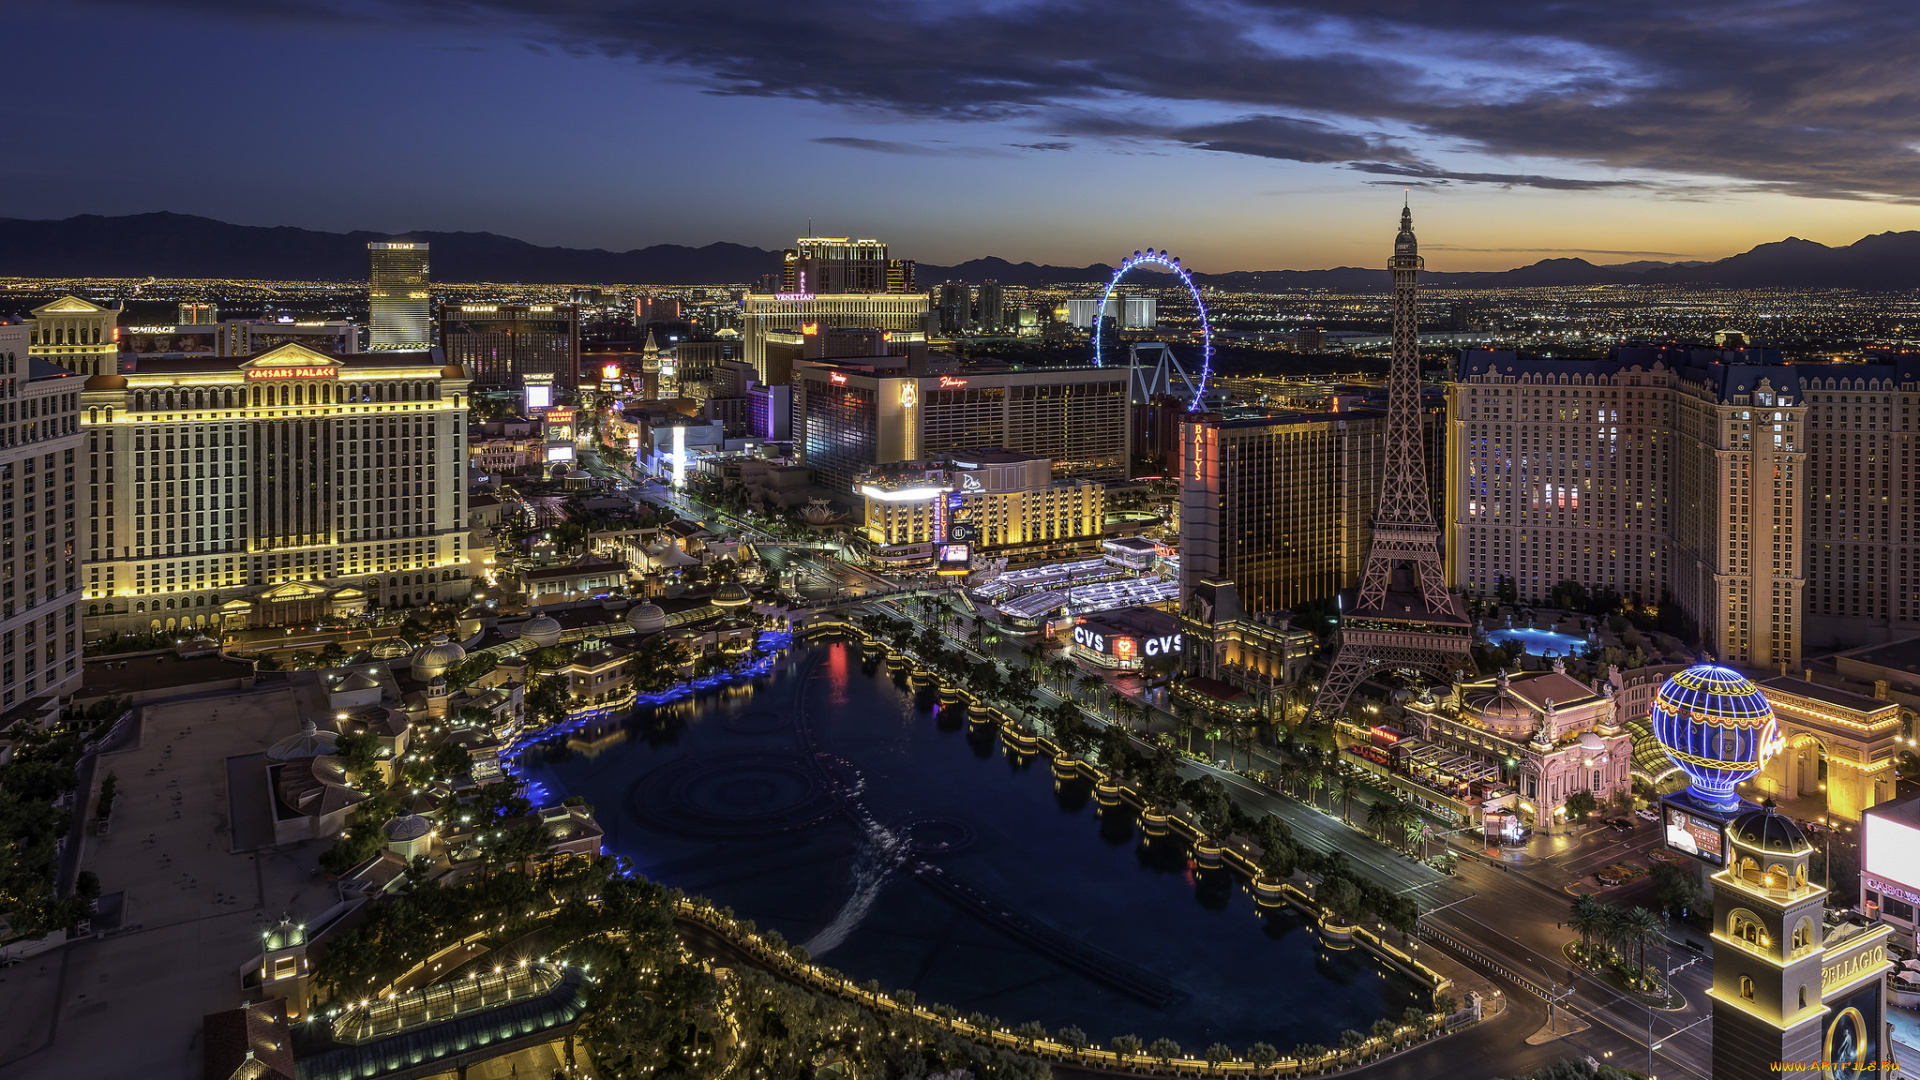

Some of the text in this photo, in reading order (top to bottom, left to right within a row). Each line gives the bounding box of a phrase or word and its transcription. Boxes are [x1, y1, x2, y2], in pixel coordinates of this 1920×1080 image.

[775, 293, 814, 301] VENETIAN
[139, 326, 176, 335] MIRAGE
[248, 368, 336, 379] CAESARS PALACE
[548, 416, 572, 424] PALACE
[1074, 626, 1104, 652] CVS
[1145, 633, 1182, 656] CVS
[1866, 878, 1905, 898] CABO
[1822, 945, 1883, 989] BELLAGIO
